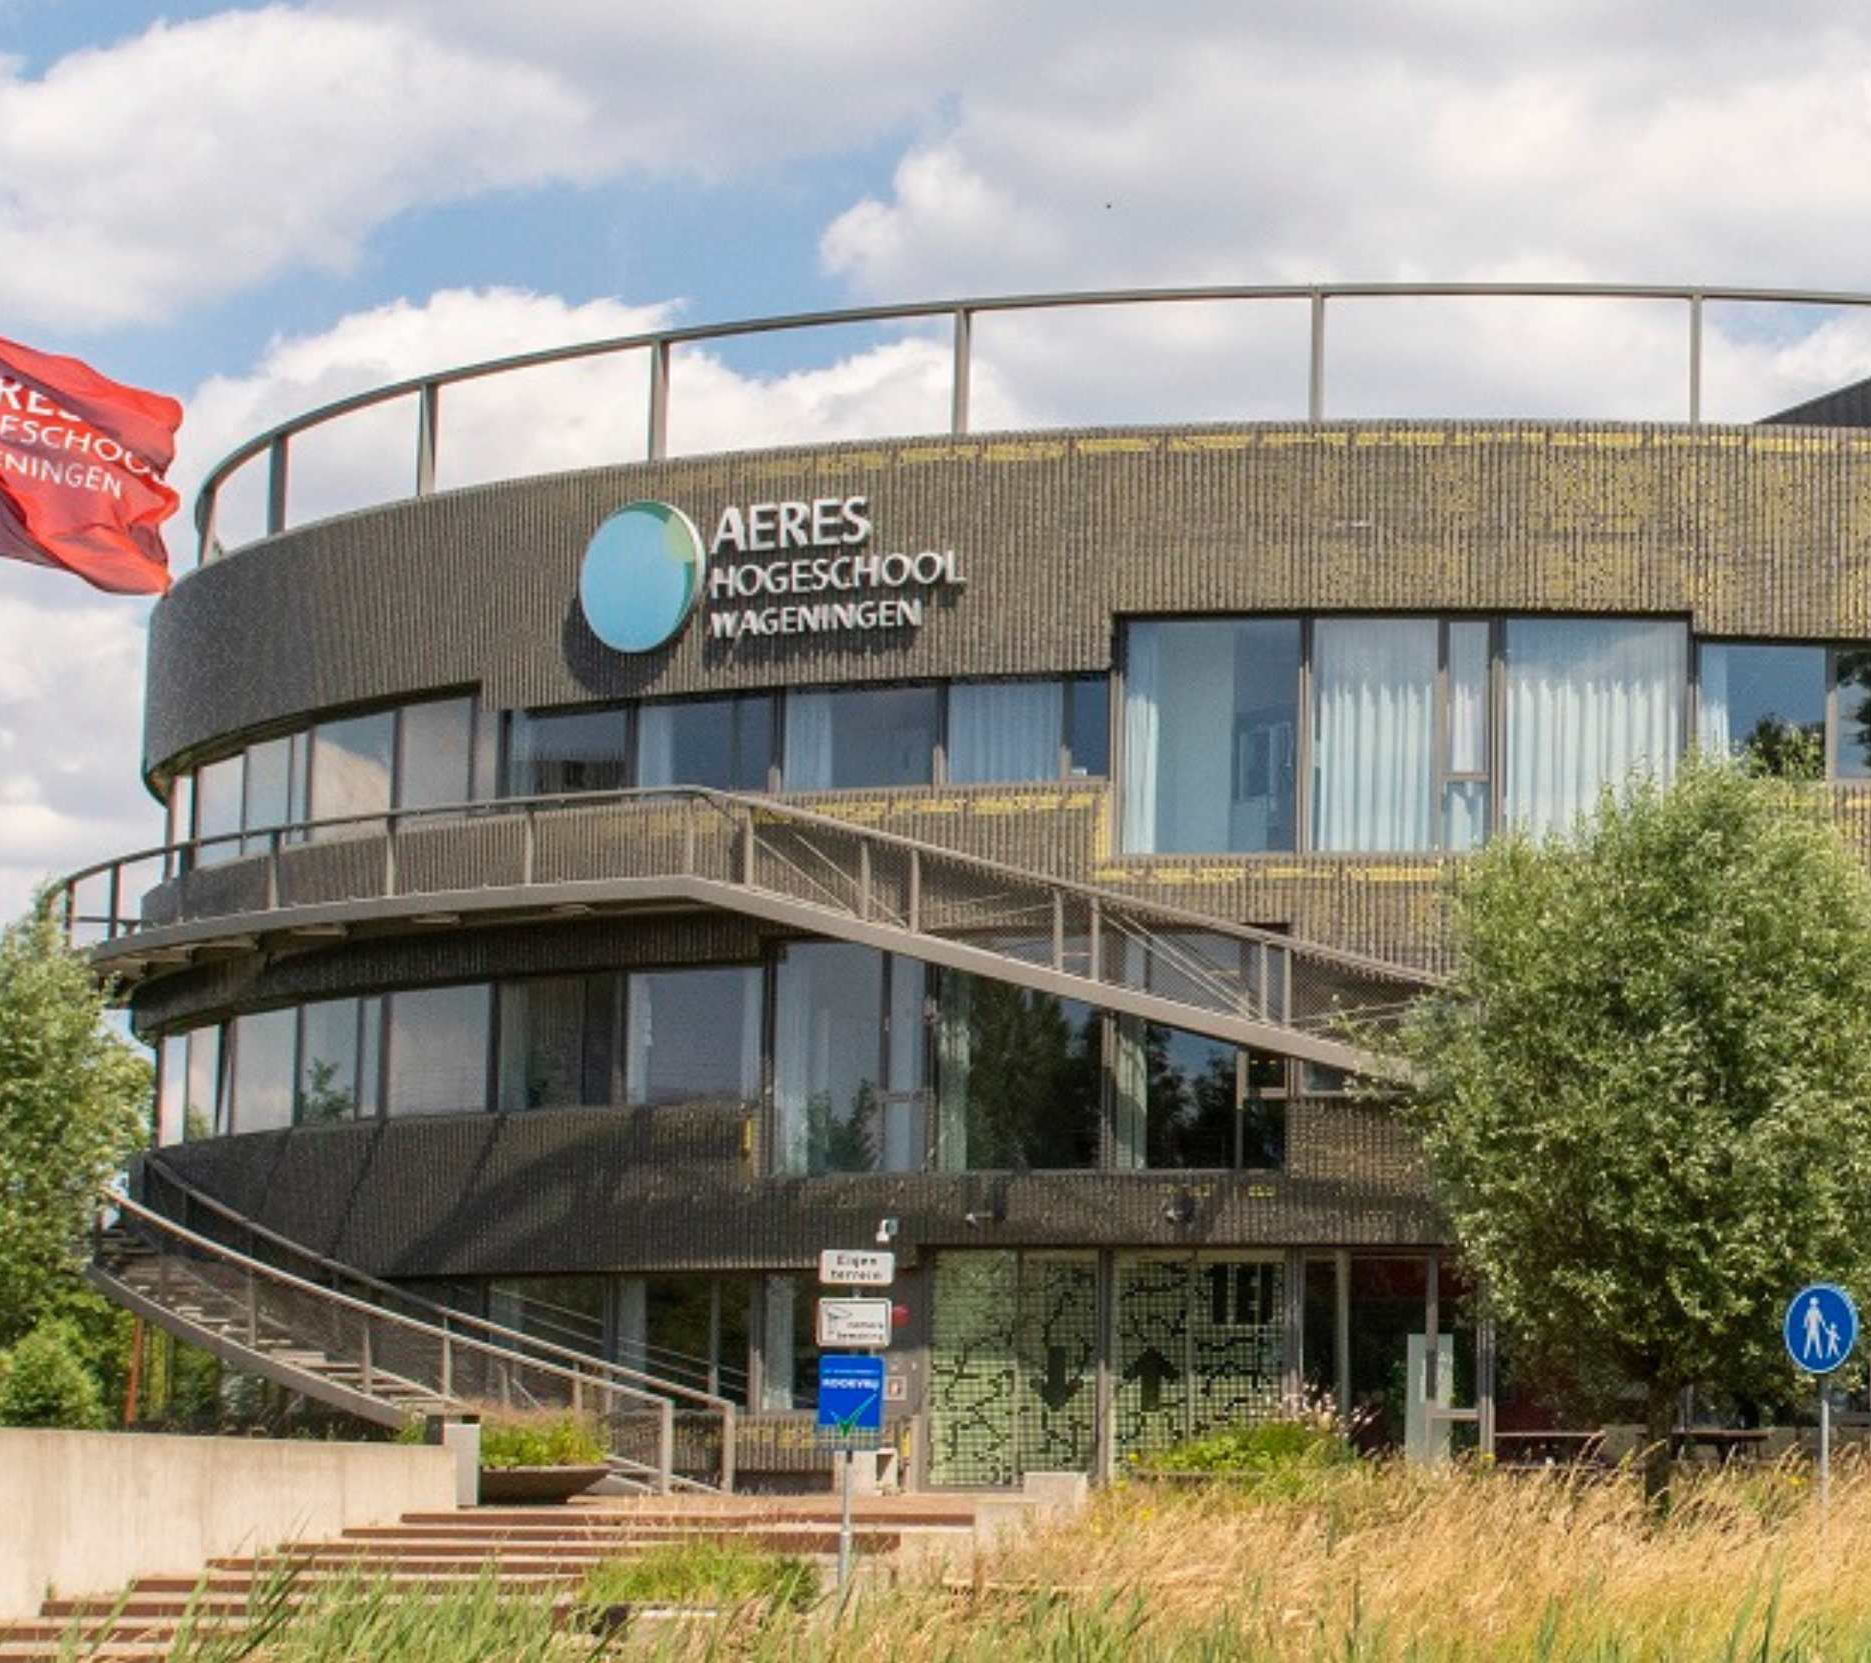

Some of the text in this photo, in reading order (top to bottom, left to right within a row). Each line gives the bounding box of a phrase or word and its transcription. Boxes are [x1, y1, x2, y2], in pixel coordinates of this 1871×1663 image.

[709, 496, 872, 554] AERES
[710, 549, 967, 600] HOGESCHOOL
[710, 597, 923, 639] WAGENINGEN
